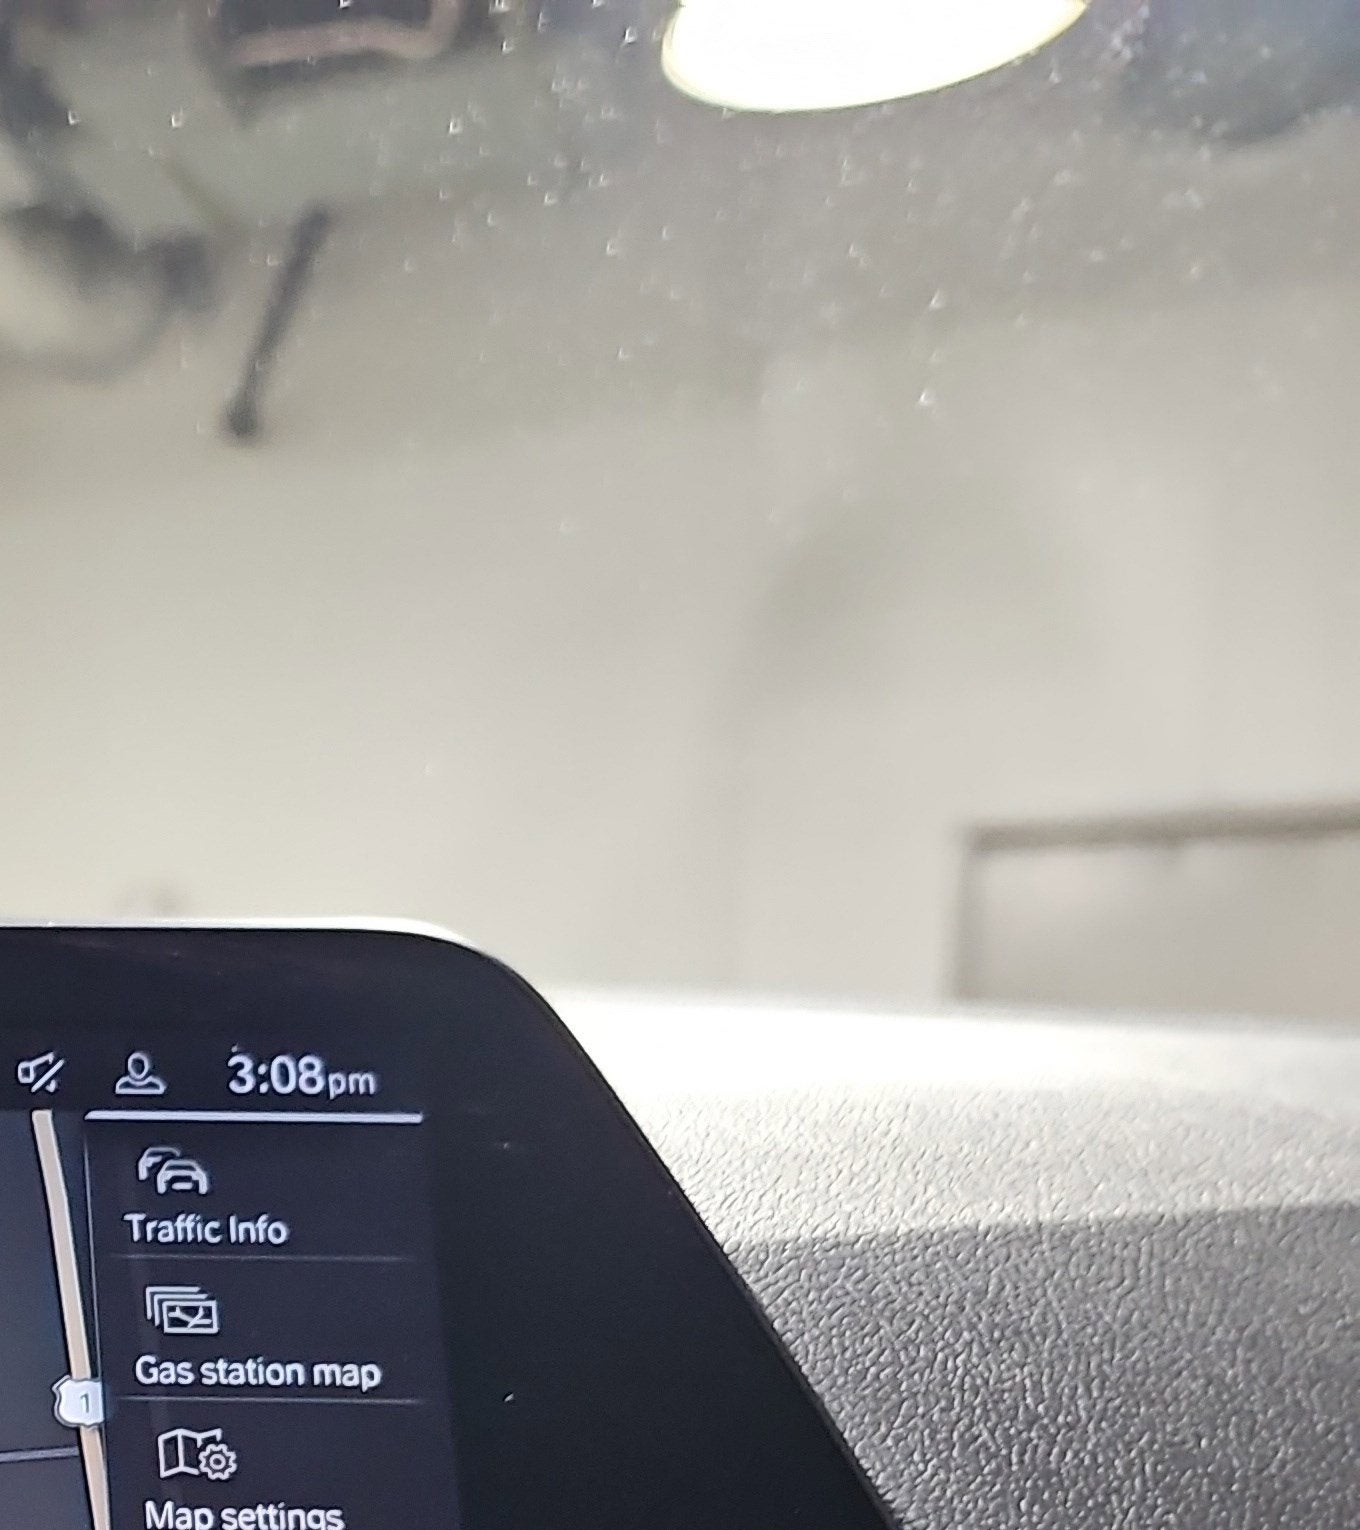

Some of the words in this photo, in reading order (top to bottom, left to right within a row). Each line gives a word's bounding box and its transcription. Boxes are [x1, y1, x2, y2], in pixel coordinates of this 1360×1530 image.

[124, 1213, 223, 1246] Traffic
[229, 1214, 288, 1247] Info
[135, 1356, 194, 1385] Gas
[201, 1356, 305, 1386] station
[313, 1364, 381, 1392] map
